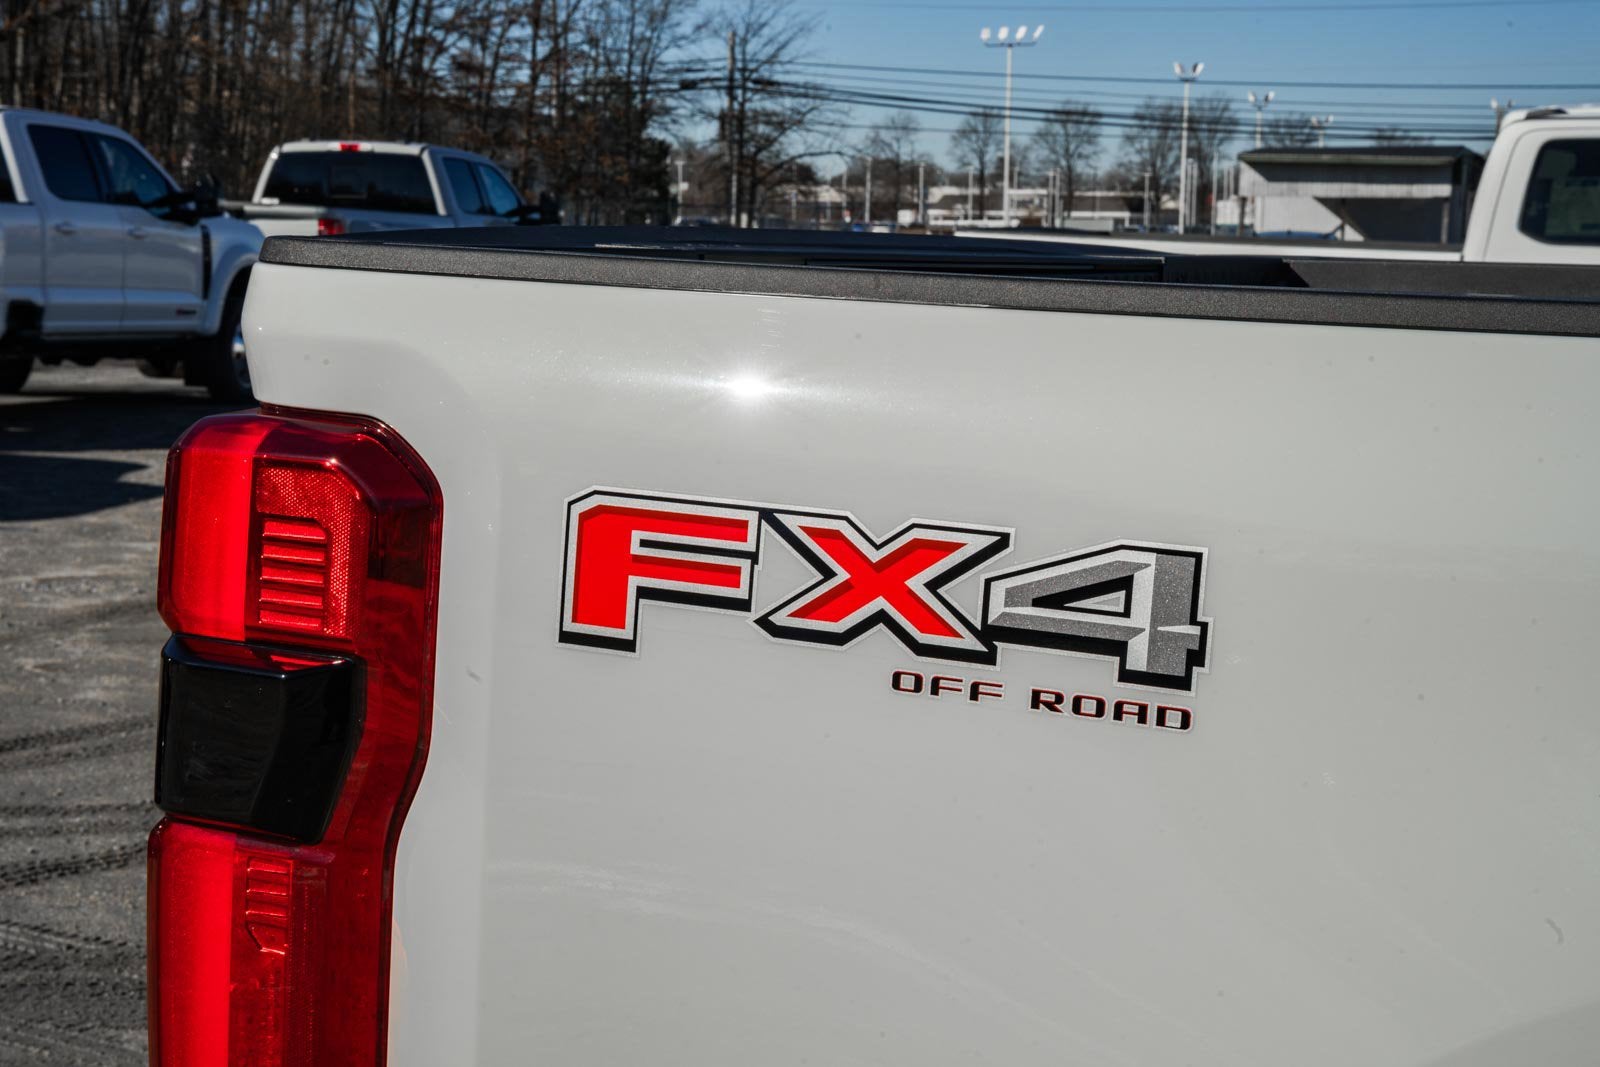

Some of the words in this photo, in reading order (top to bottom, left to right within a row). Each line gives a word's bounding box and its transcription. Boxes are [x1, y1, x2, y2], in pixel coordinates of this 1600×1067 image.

[558, 488, 1208, 692] FX4
[891, 670, 1004, 702] OFF
[1030, 688, 1192, 730] ROAD
